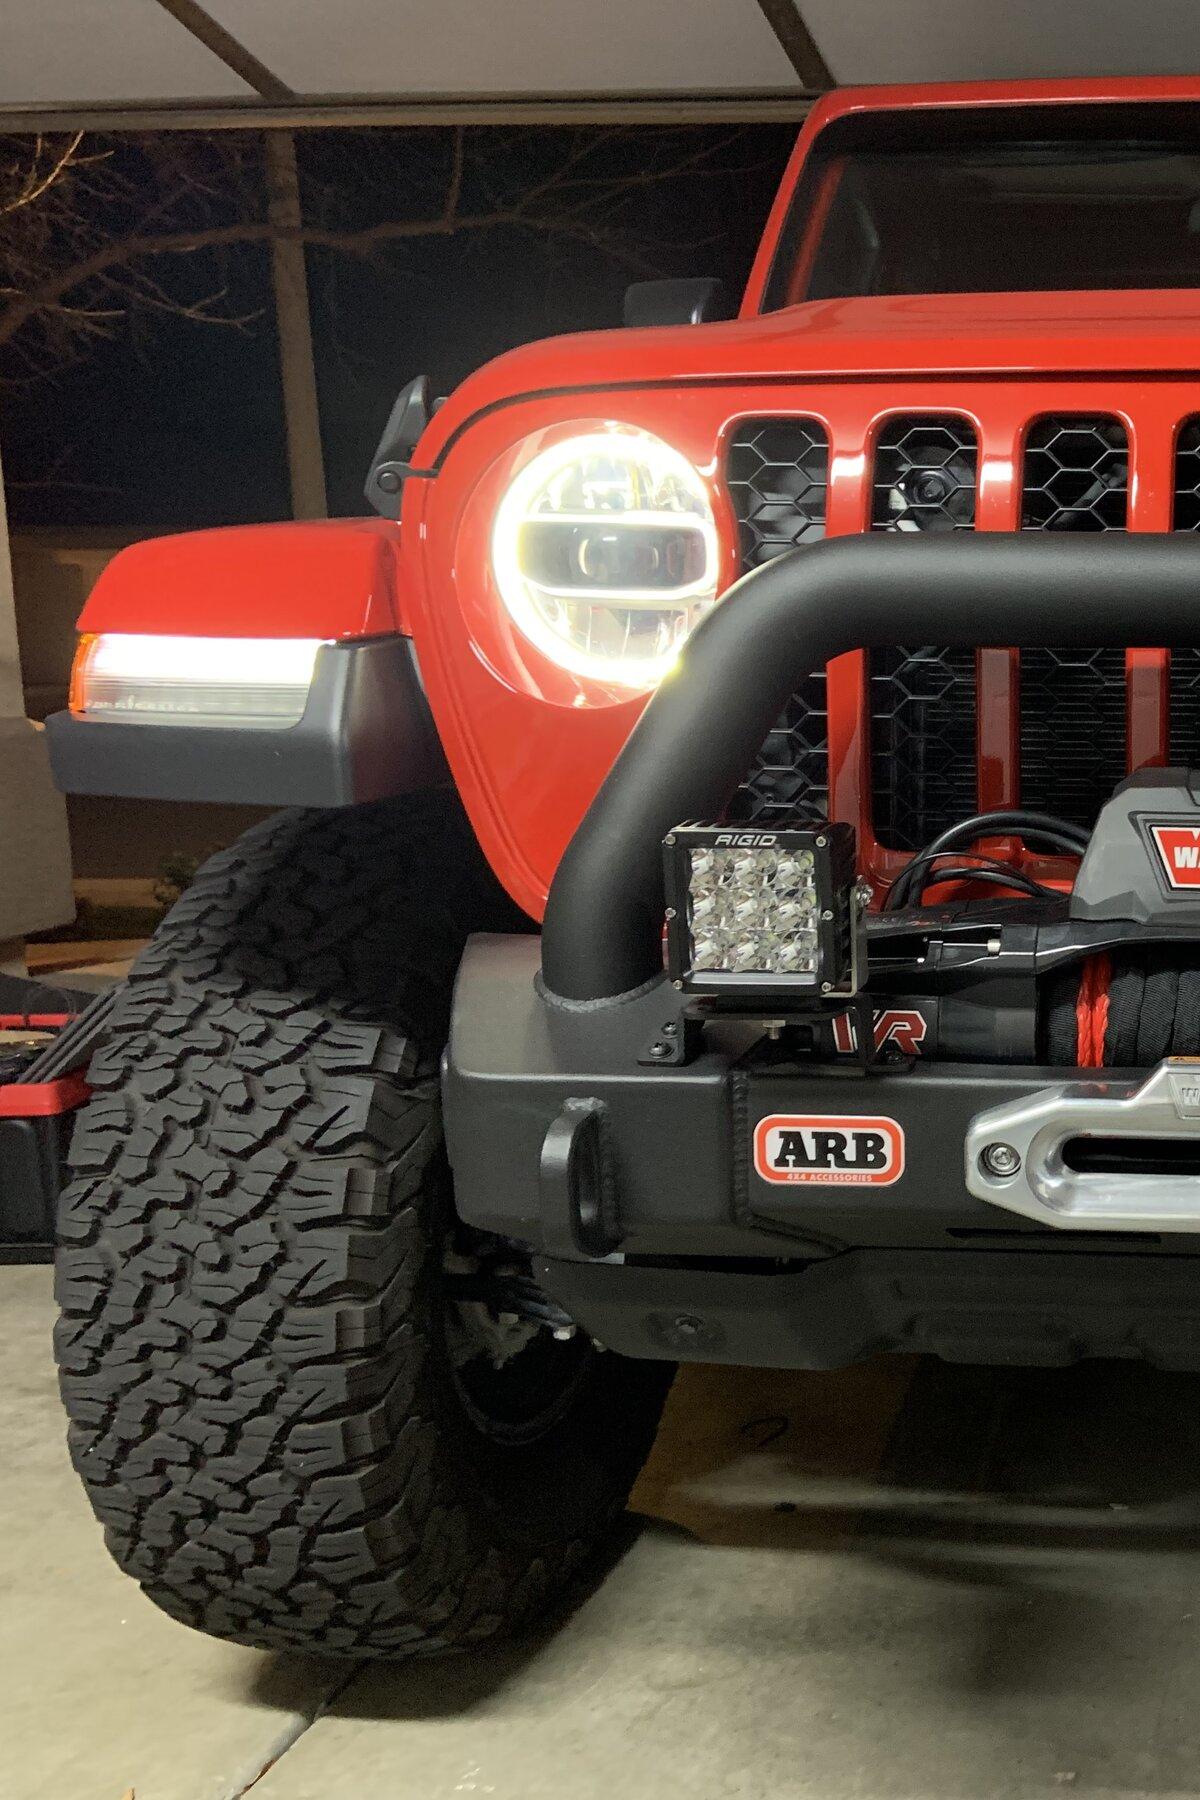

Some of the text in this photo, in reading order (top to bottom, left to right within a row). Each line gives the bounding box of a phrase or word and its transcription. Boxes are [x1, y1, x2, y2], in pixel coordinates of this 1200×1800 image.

[714, 834, 777, 847] RIGID
[774, 1130, 887, 1168] ARB
[809, 1173, 873, 1182] ACCESSORIES
